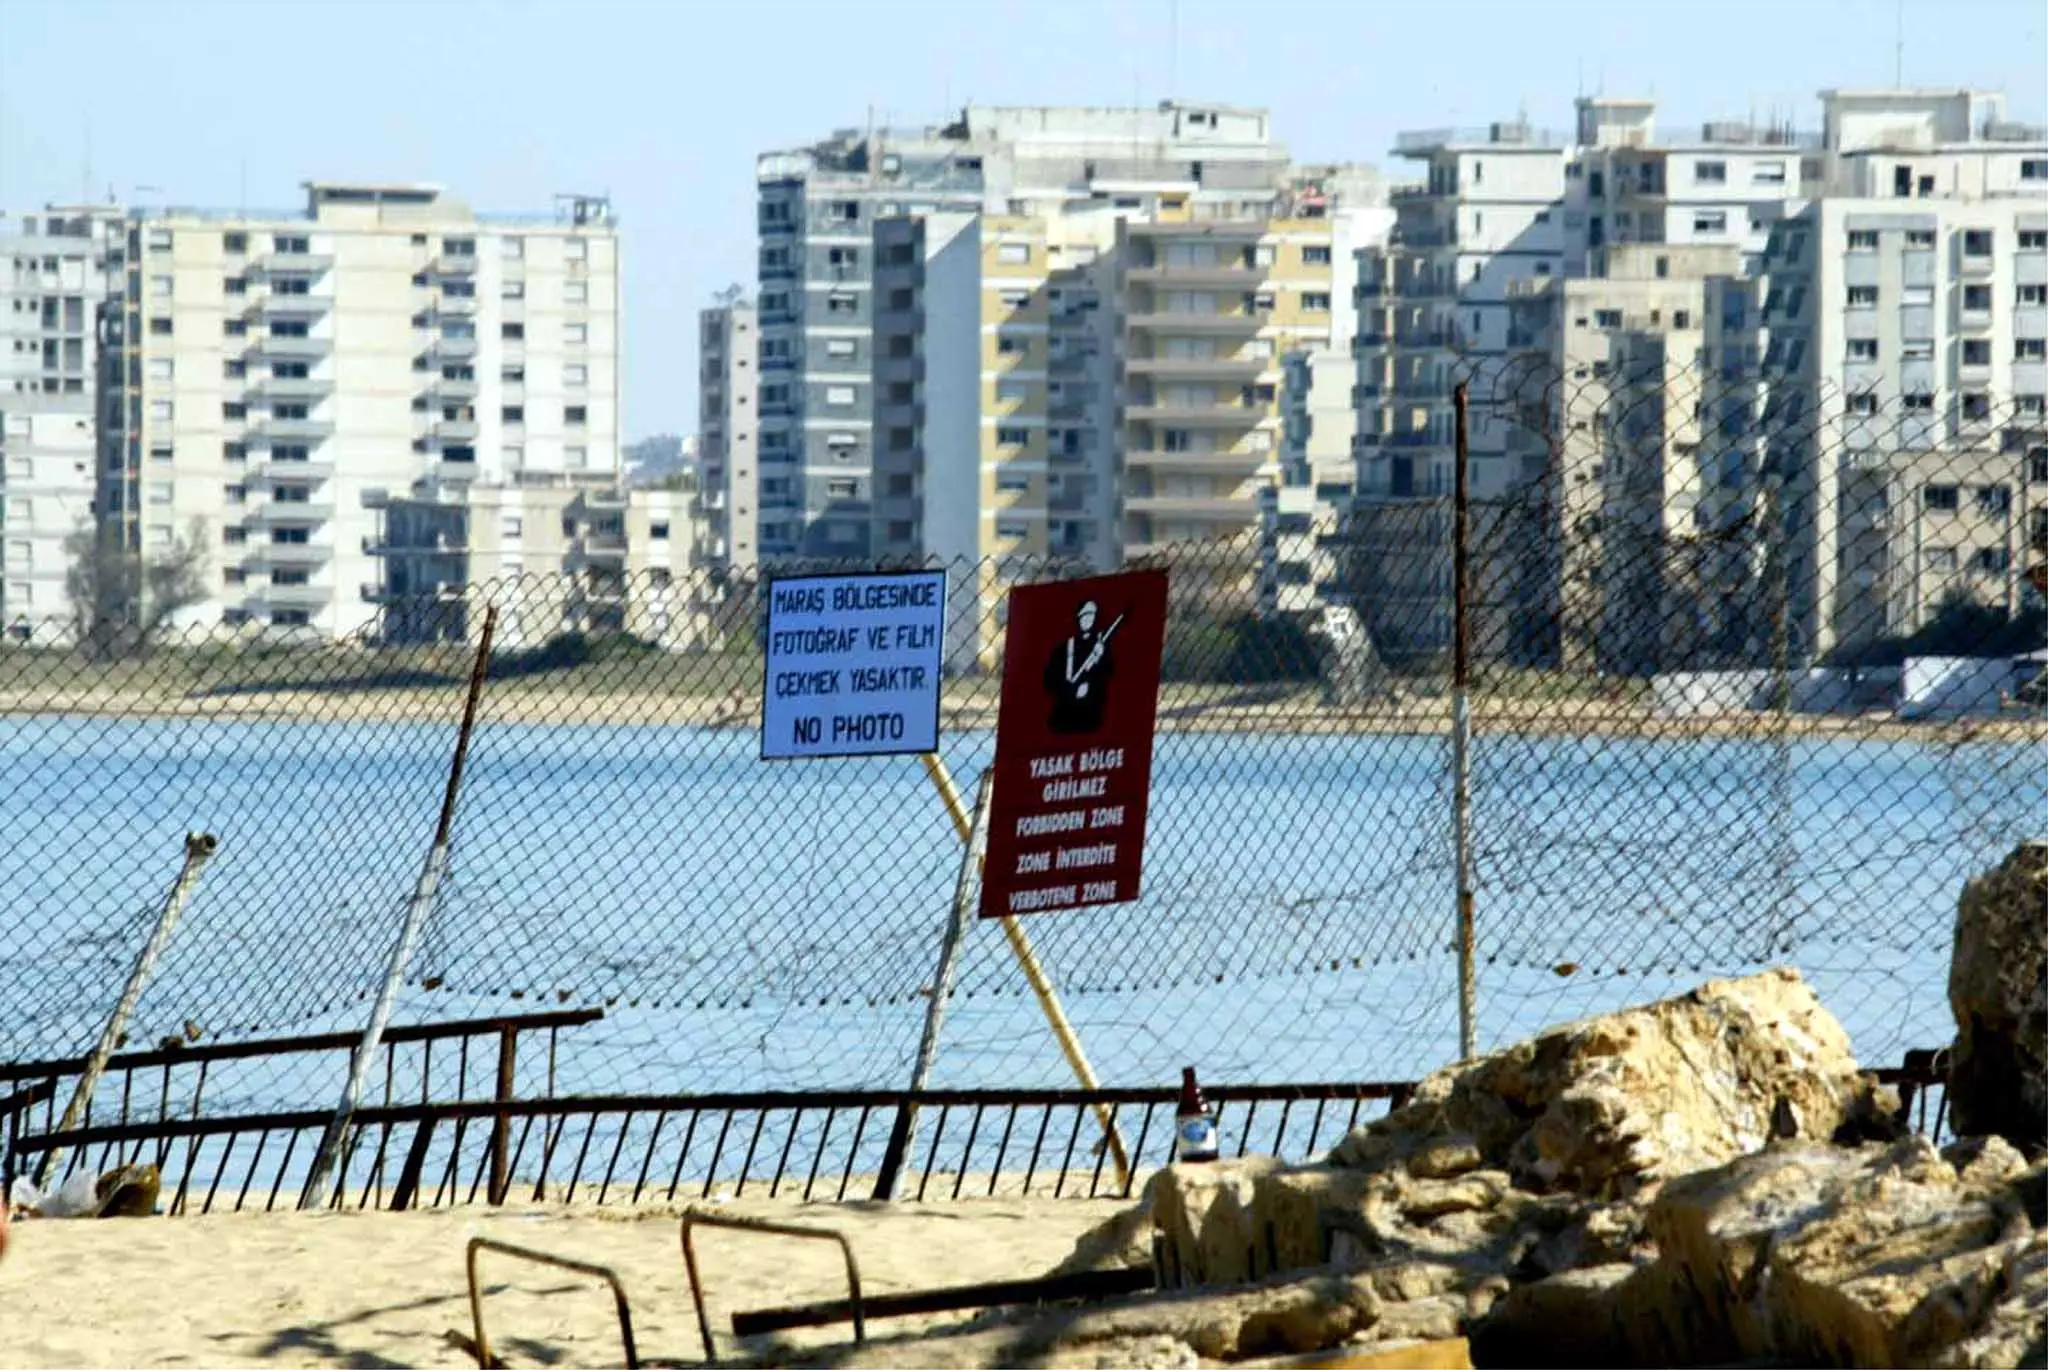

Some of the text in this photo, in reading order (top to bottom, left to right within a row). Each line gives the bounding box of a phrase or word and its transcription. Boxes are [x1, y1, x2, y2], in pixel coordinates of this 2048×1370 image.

[867, 625, 889, 651] VE
[794, 713, 904, 745] NO PHOTO
[1030, 747, 1125, 778] YASAK BÖLGE
[1042, 775, 1108, 803] GİRİLMEZ
[1015, 805, 1125, 838] FORBIDDEN ZONE
[1015, 850, 1051, 875] ZONE
[1008, 880, 1117, 912] VERBOTENE ZONE
